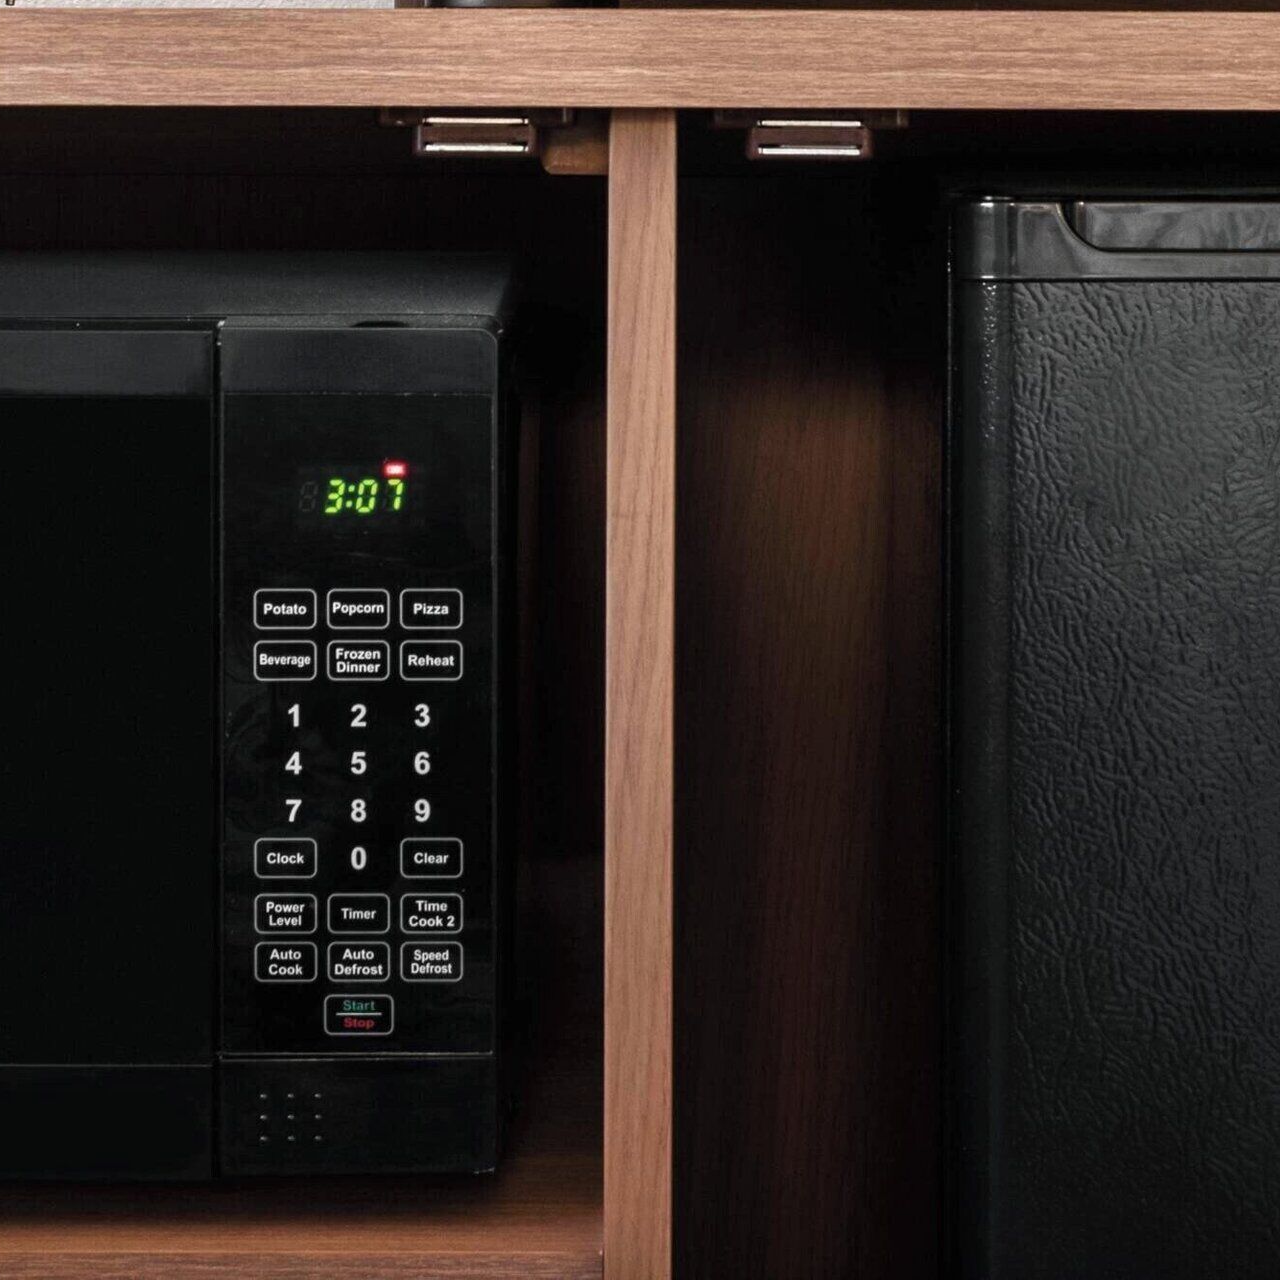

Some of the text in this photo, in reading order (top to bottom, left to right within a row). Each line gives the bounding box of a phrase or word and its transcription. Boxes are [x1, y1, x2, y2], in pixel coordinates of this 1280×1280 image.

[324, 479, 404, 513] 3:07
[263, 602, 307, 616] Potato
[332, 601, 385, 617] Popcorn
[413, 602, 450, 616] Pizza
[259, 653, 312, 668] Beverage
[335, 647, 381, 660] Frozen
[407, 653, 455, 667] Reheat
[336, 660, 381, 673] Dinner
[287, 703, 300, 728] 1
[350, 703, 367, 728] 2
[414, 703, 431, 728] 3
[284, 751, 303, 775] 4
[350, 751, 368, 776] 5
[414, 751, 431, 776] 6
[285, 798, 303, 823] 7
[350, 798, 367, 823] 8
[414, 798, 431, 823] 9
[266, 852, 305, 865] Clock
[350, 846, 367, 871] 0
[413, 852, 449, 865] Clear
[265, 901, 305, 914] Power
[415, 899, 448, 912] Time
[268, 914, 303, 927] Level
[340, 907, 377, 920] Timer
[408, 915, 455, 927] Cook 2
[269, 948, 302, 960] Auto
[342, 948, 375, 960] Auto
[413, 949, 450, 963] Speed
[268, 963, 303, 976] Cook
[334, 963, 383, 976] Defrost
[410, 962, 453, 975] Defrost
[342, 999, 376, 1012] Start
[343, 1017, 375, 1030] Stop
